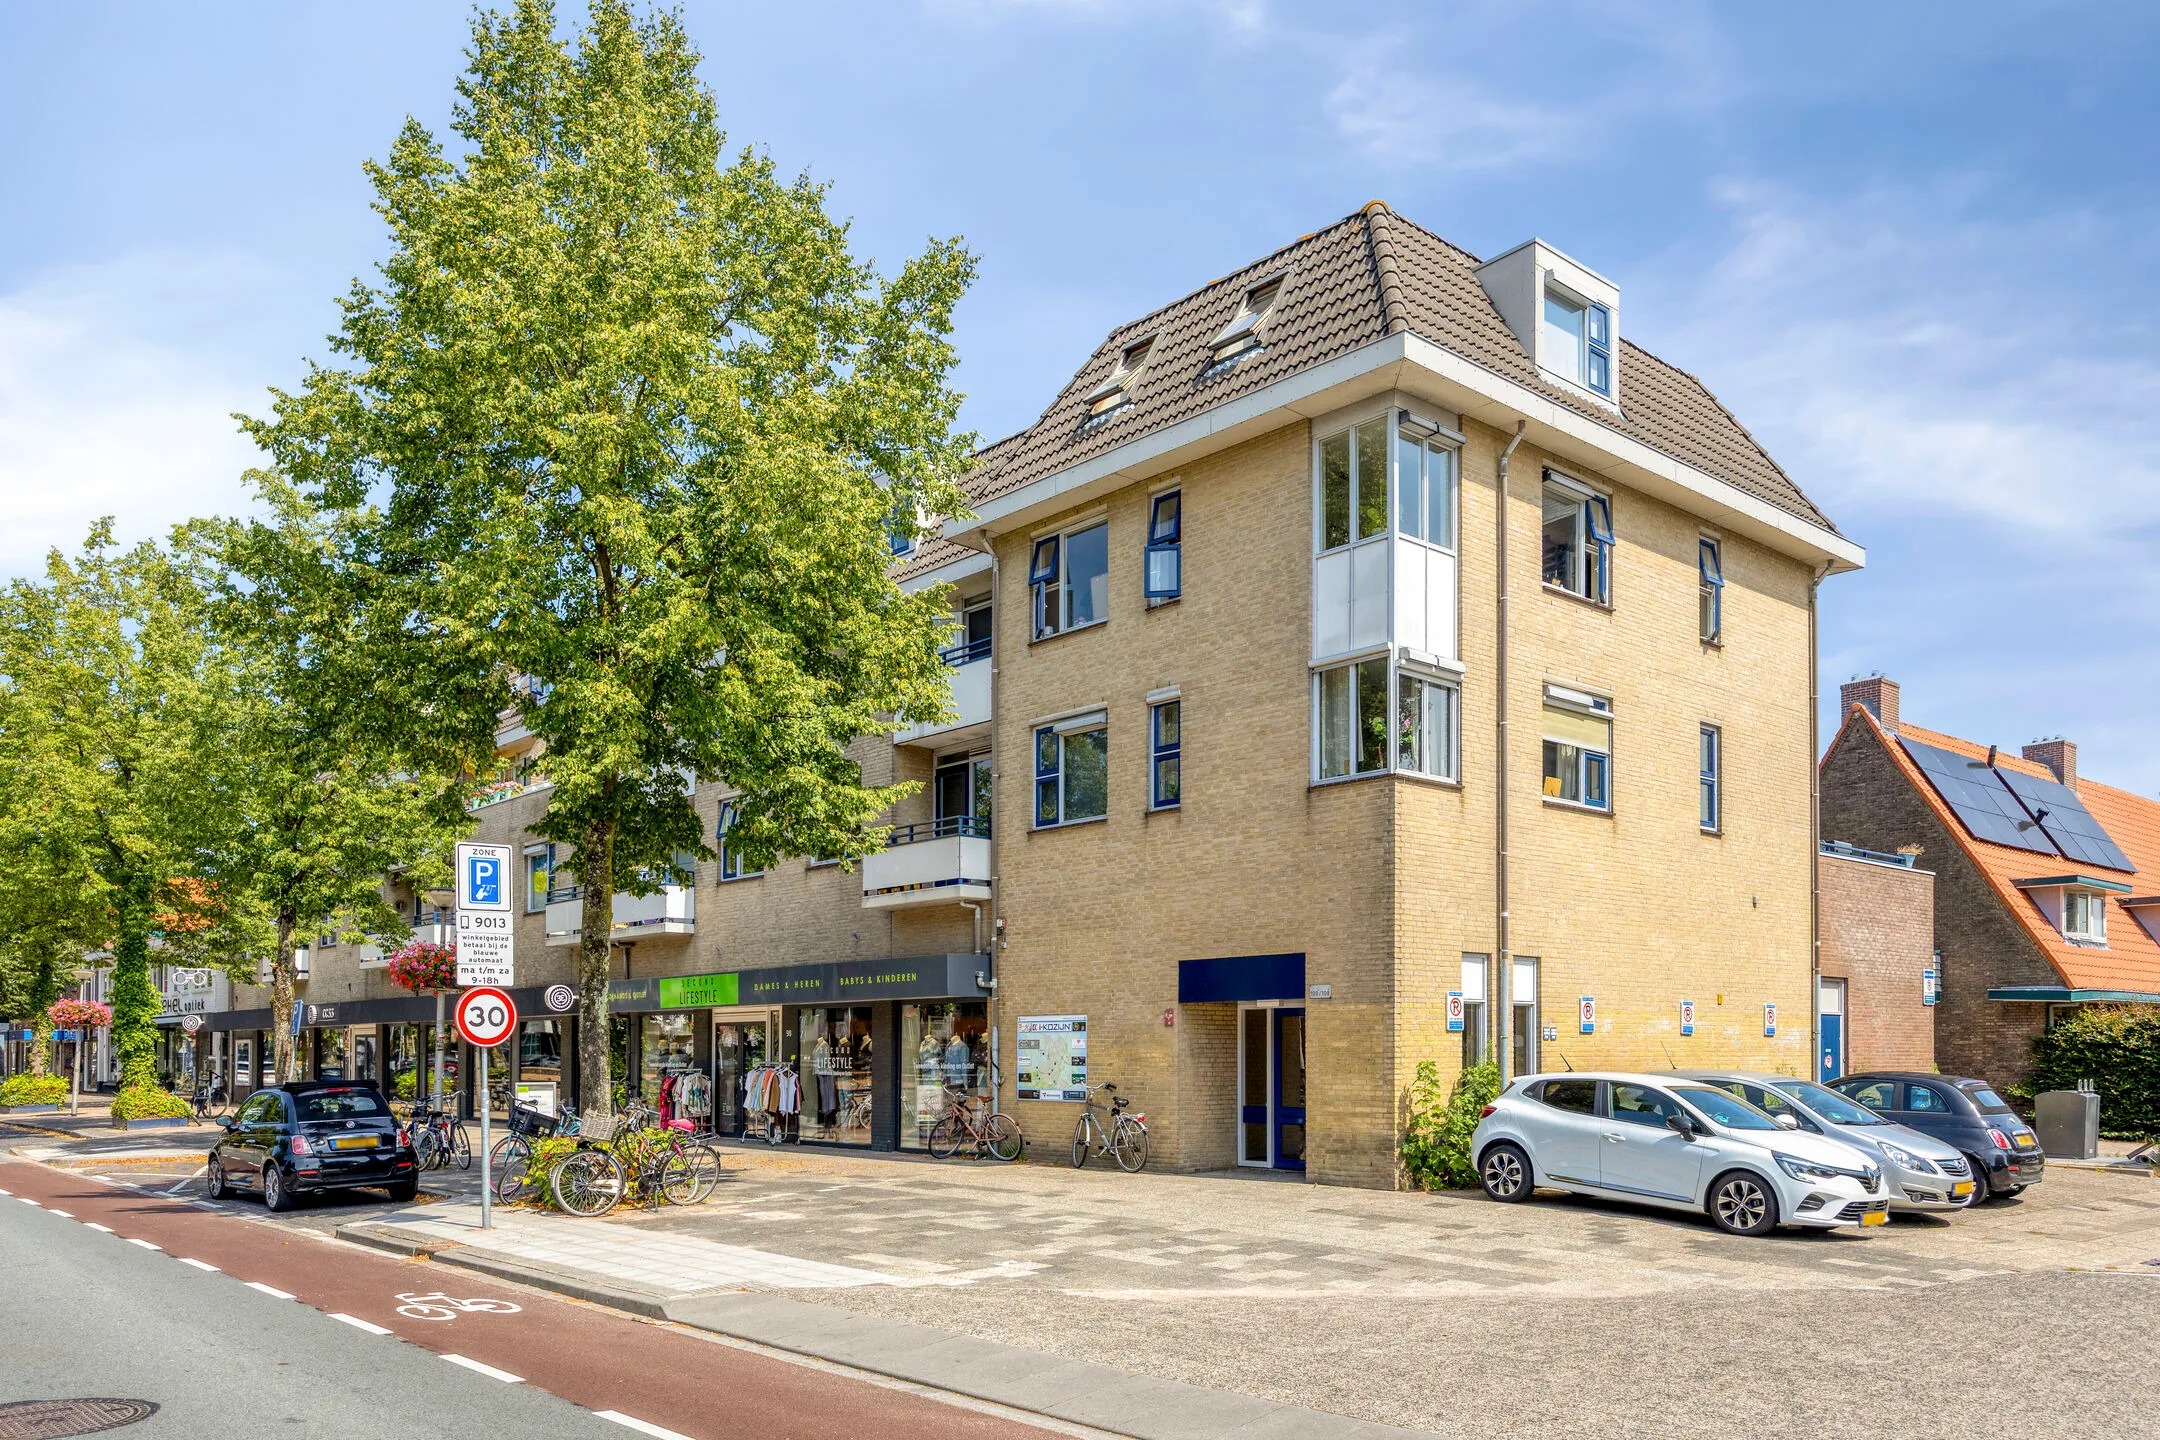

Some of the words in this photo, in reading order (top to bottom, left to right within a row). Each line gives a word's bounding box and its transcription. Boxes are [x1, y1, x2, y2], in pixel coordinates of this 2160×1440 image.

[472, 848, 496, 856] ZONE
[476, 862, 493, 885] P
[475, 917, 506, 928] 9013
[462, 934, 509, 942] winkelgebied
[479, 966, 495, 974] t/m
[471, 976, 499, 984] 9-18h
[682, 978, 715, 987] SECOND
[754, 981, 780, 991] DAMES
[794, 979, 821, 989] HEREN
[840, 977, 864, 986] BABYS
[868, 976, 872, 984] &
[876, 973, 917, 983] KINDEREN
[680, 990, 717, 1005] LIFESTYLE
[184, 998, 205, 1013] optiek
[468, 1006, 505, 1027] 30
[817, 1057, 853, 1068] LIFESTYLE
